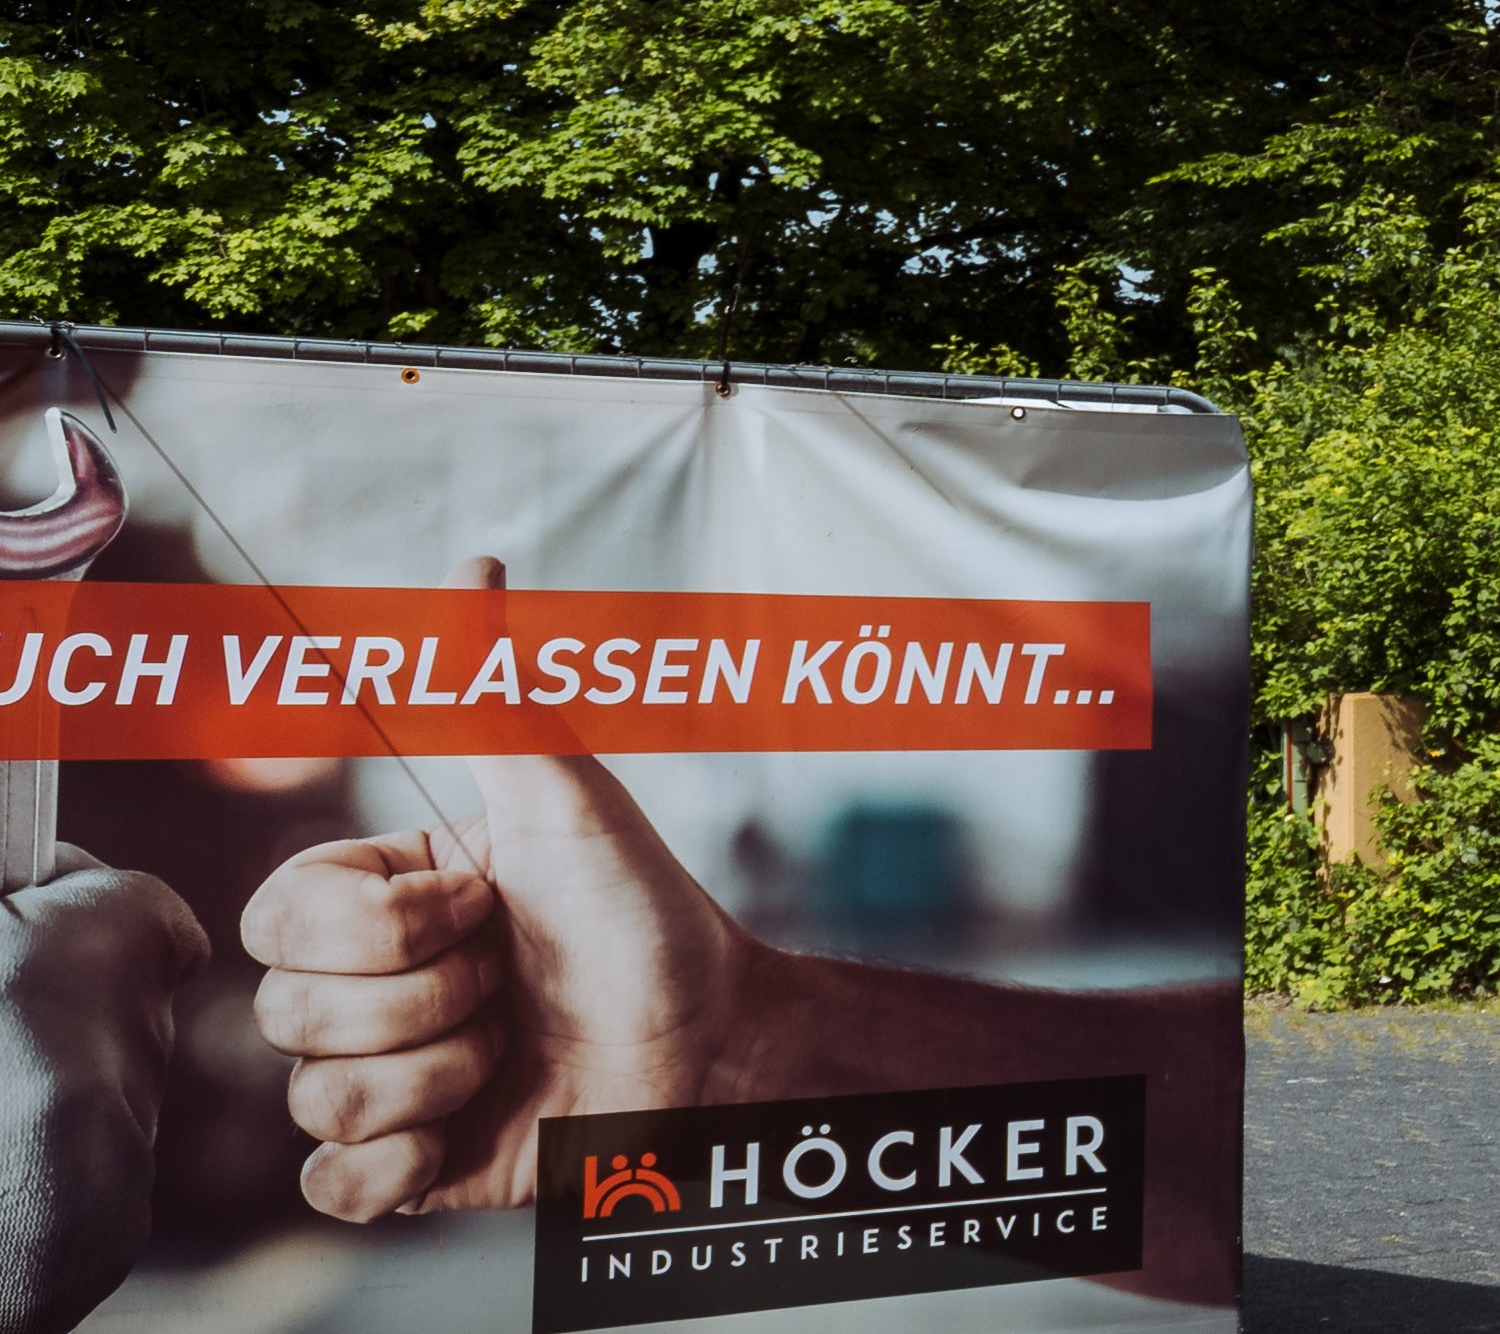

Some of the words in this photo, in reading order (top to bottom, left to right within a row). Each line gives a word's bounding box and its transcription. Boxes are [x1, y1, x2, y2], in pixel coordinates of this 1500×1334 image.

[222, 634, 760, 706] VERLASSEN
[782, 625, 1115, 705] KÖNNT...
[709, 1115, 1108, 1208] HÖCKER
[581, 1206, 1108, 1282] INDUSTRIESERVICE
